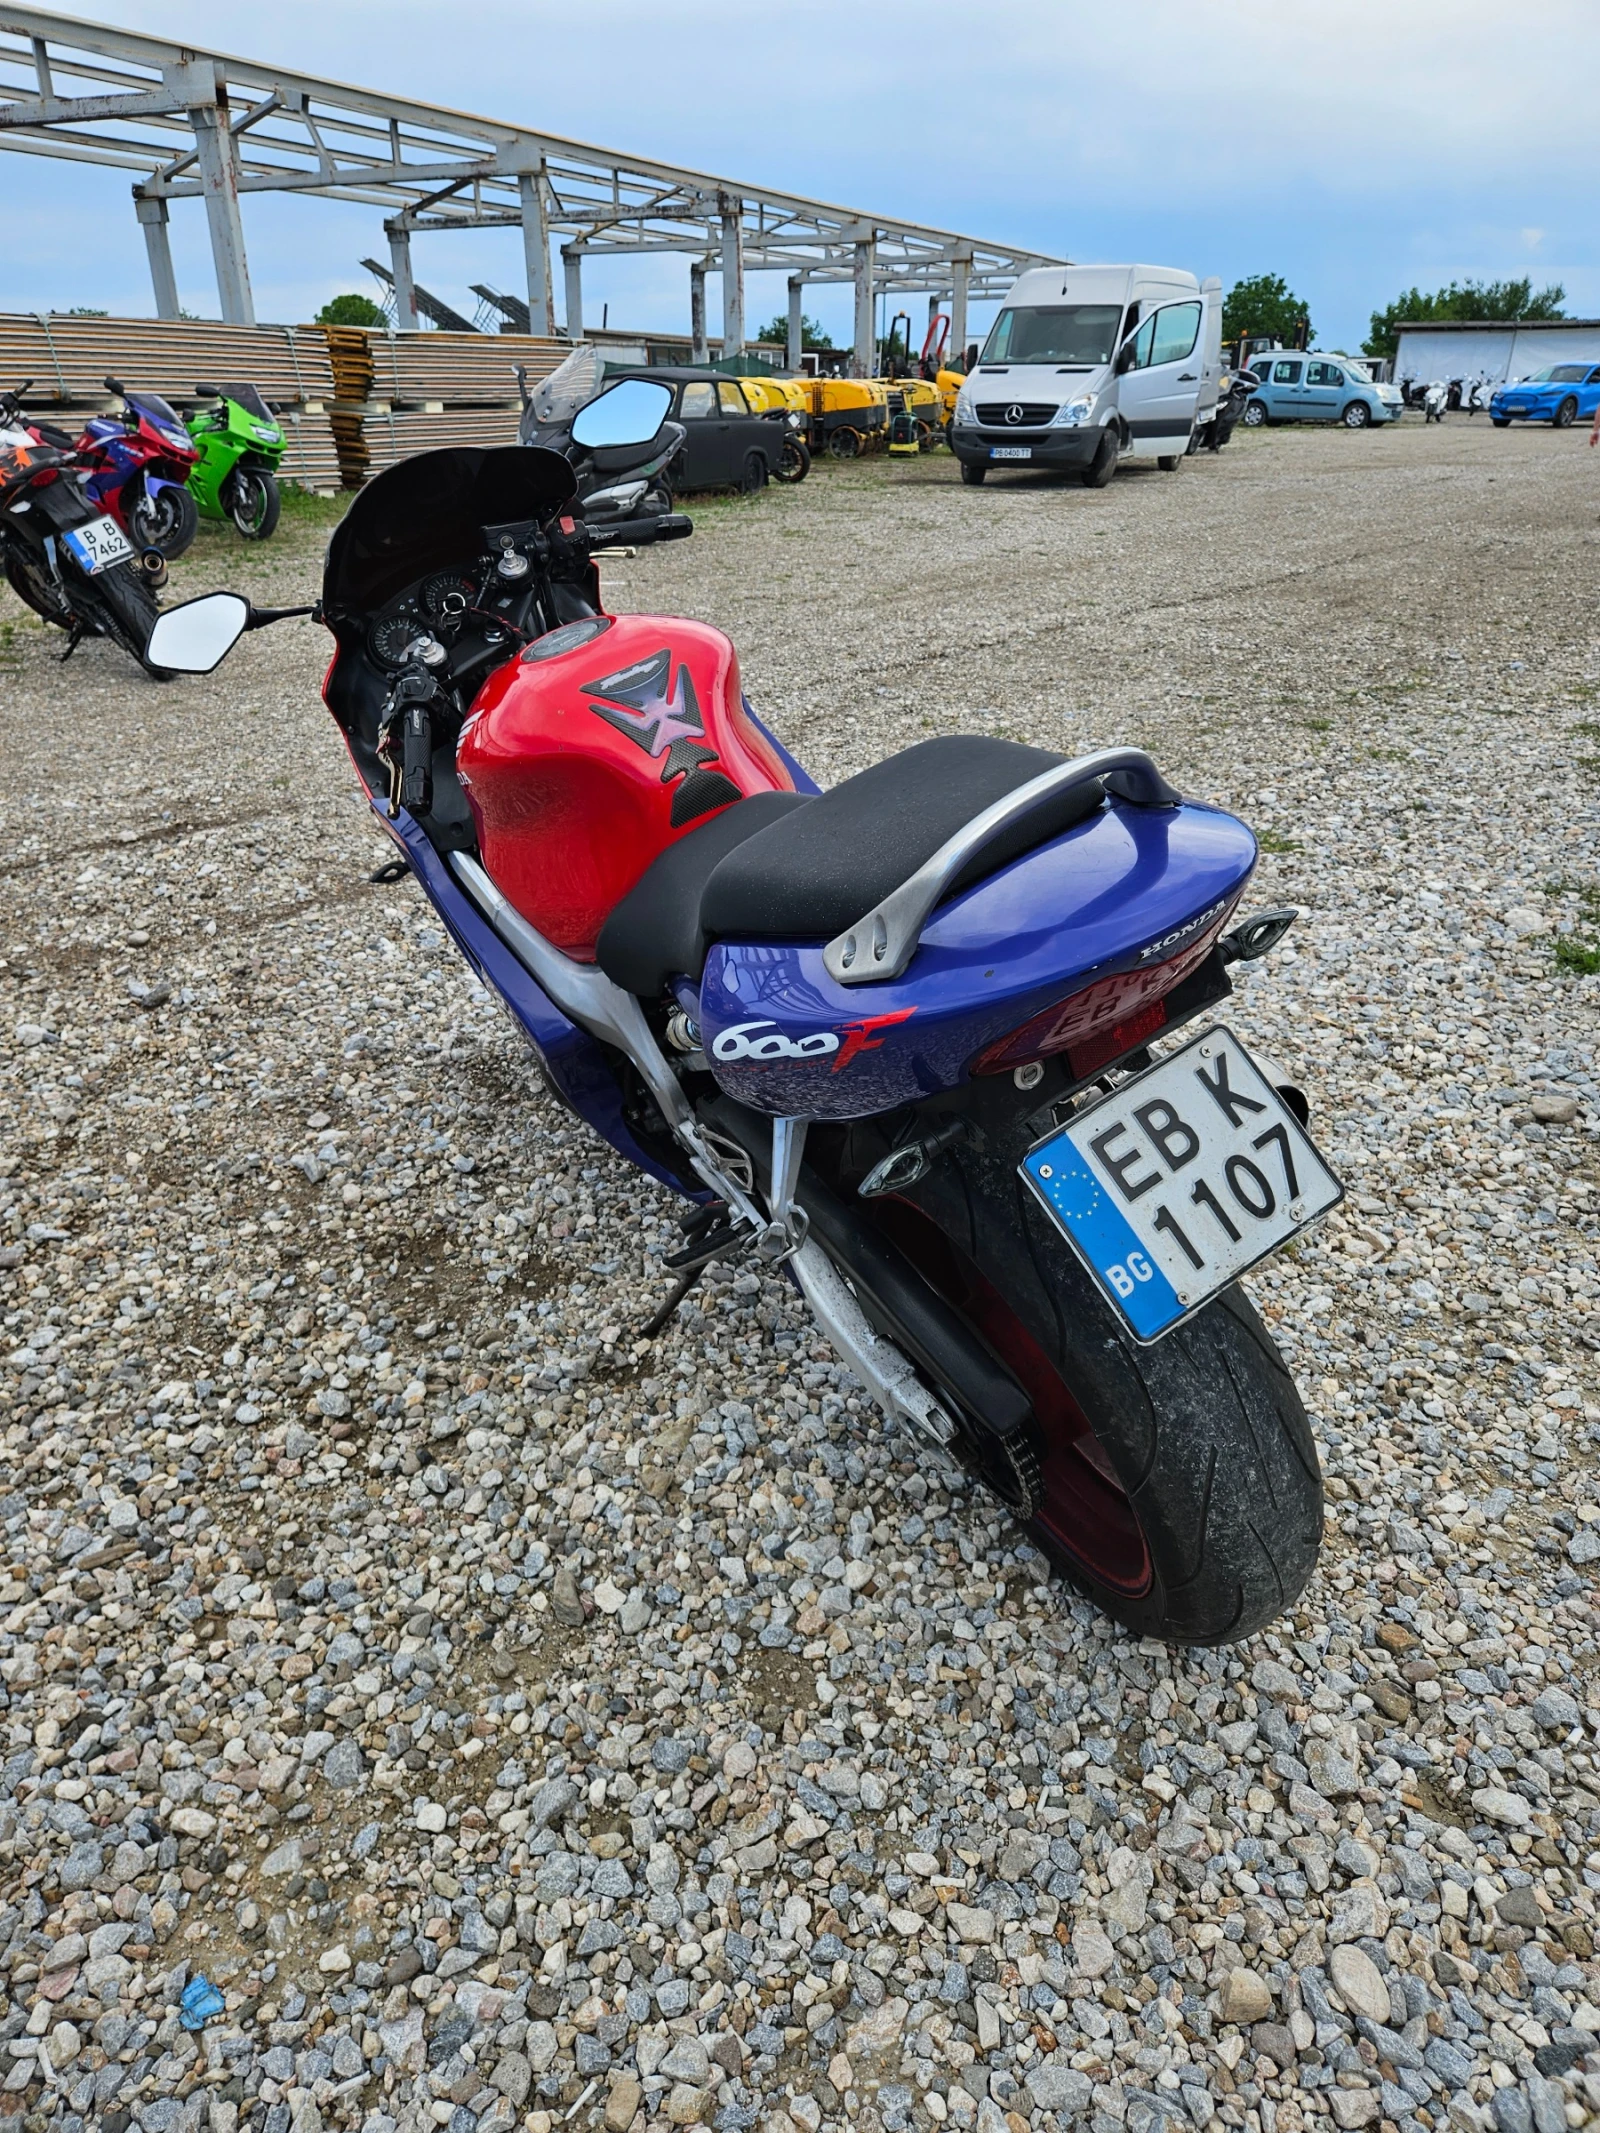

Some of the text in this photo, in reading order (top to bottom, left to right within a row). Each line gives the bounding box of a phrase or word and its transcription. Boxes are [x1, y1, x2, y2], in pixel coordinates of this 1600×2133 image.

[83, 522, 115, 544] B B
[88, 537, 127, 561] 7462
[1141, 900, 1226, 959] HONDA
[1090, 1052, 1267, 1203] EB K
[1153, 1122, 1300, 1271] 1107
[1105, 1252, 1154, 1298] BG
